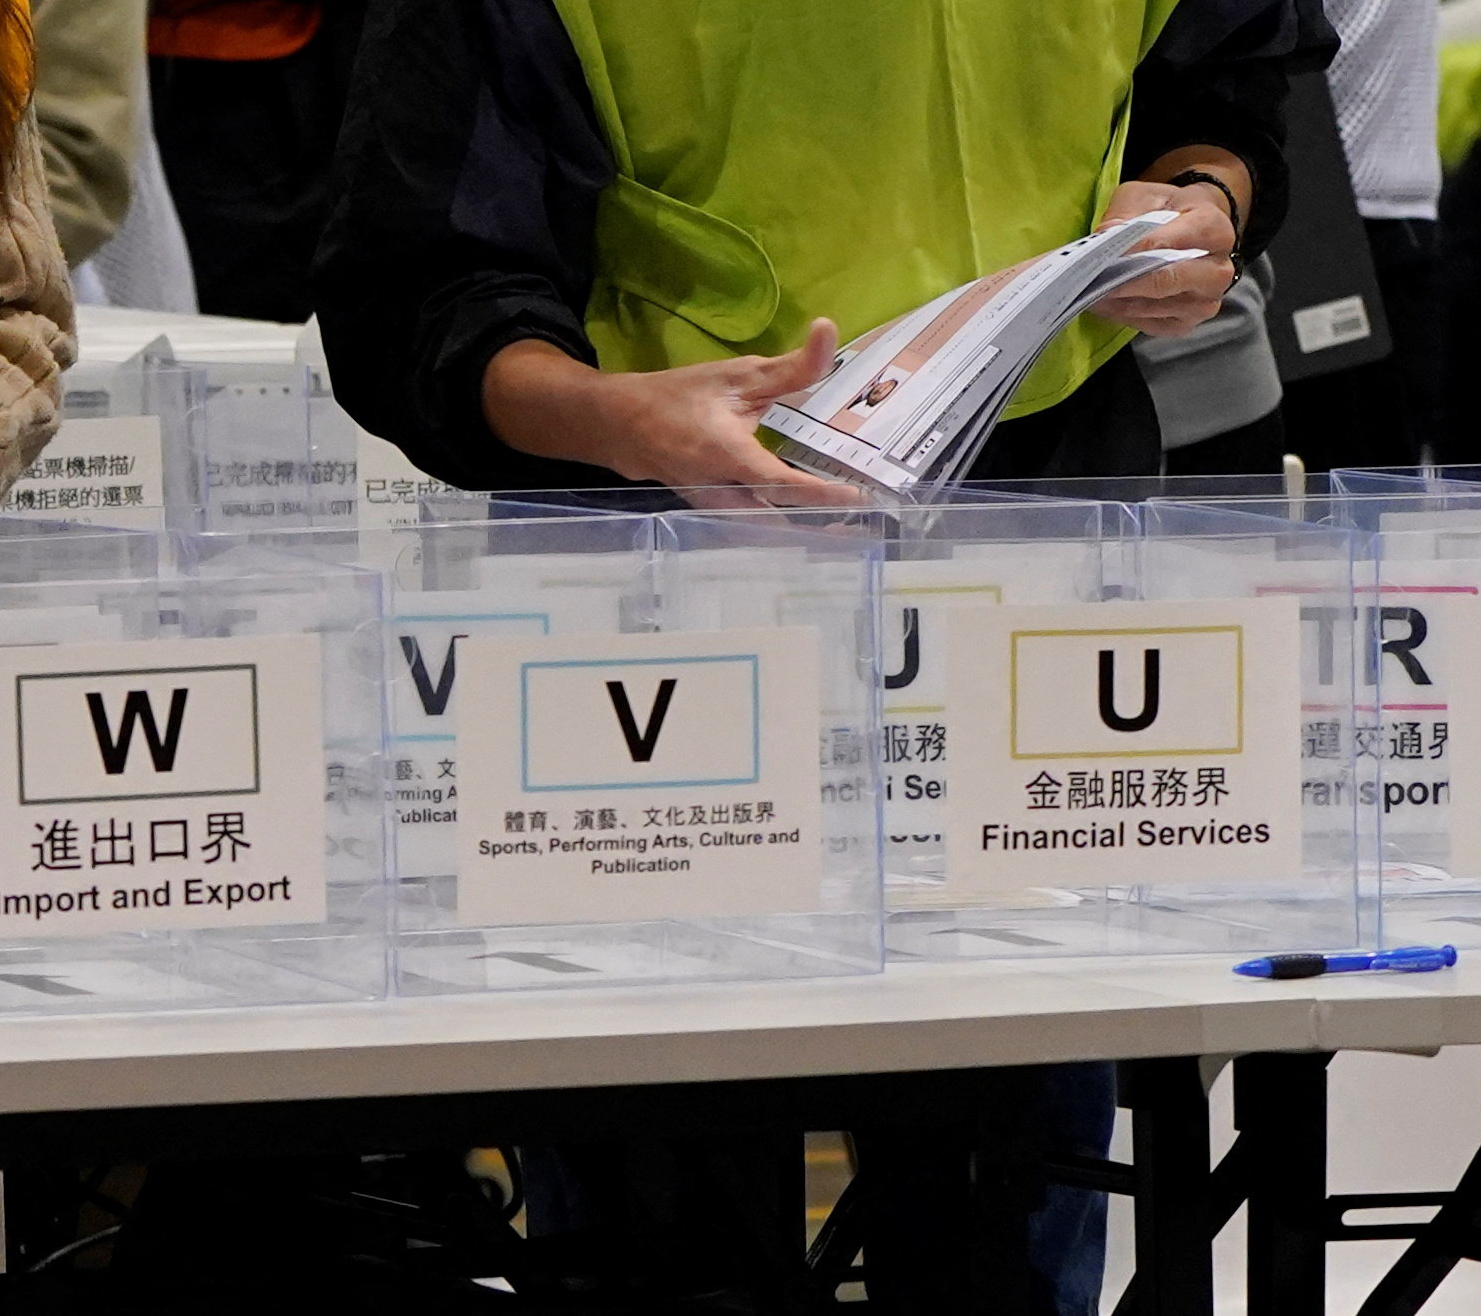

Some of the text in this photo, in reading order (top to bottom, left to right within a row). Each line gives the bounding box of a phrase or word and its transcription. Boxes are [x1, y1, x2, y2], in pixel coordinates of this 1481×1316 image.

[1096, 647, 1163, 733] U
[85, 688, 189, 776] W
[605, 678, 678, 763] V
[1025, 767, 1231, 813] 金融服務界
[502, 801, 776, 837] 體育、演藝、文化及出版界
[980, 817, 1272, 852] Financial Services
[30, 811, 251, 876] 進出口界
[478, 828, 800, 860] Sports, Performing Arts, Culture and
[590, 854, 691, 876] Publication
[110, 879, 172, 913] and
[184, 873, 292, 910] Export
